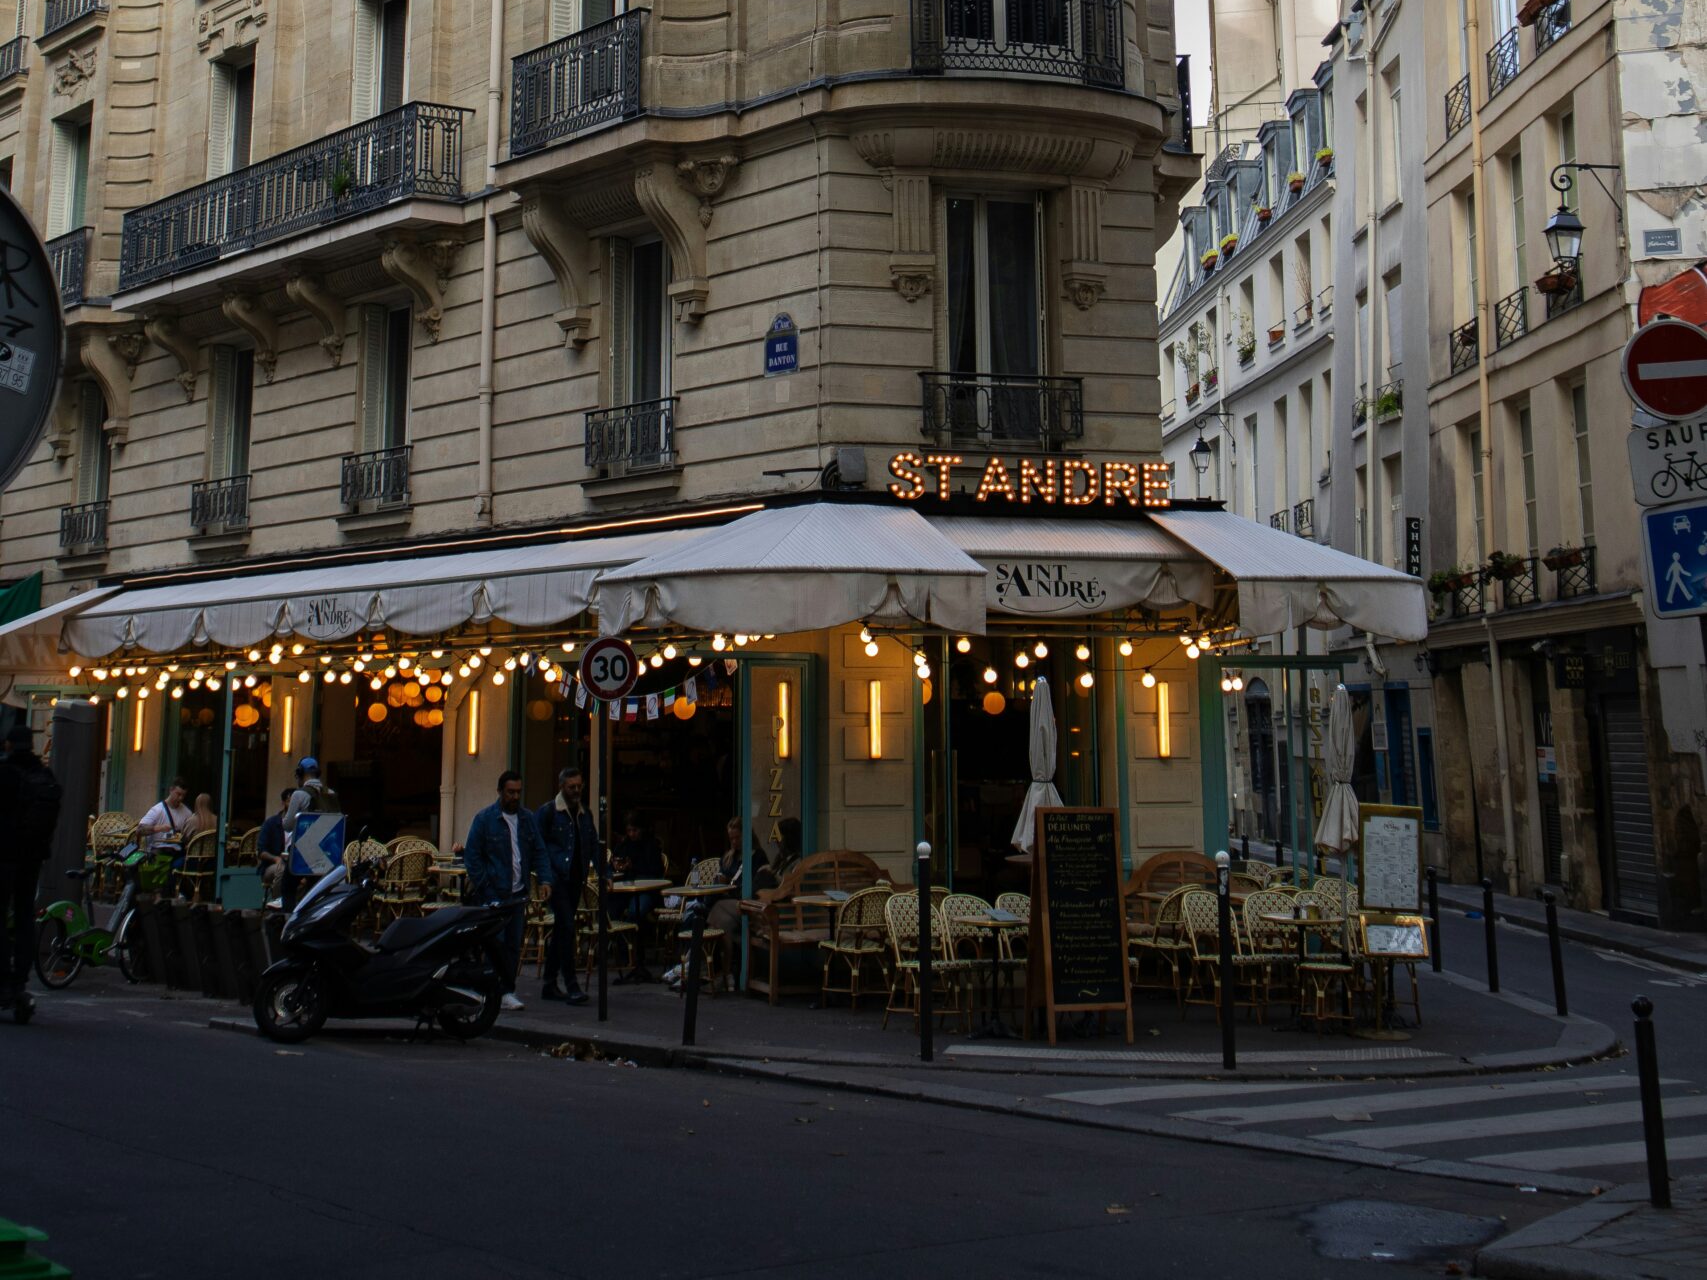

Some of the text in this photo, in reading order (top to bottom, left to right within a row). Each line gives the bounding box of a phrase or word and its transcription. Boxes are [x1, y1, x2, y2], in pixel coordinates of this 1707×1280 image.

[768, 354, 796, 367] DANTON
[775, 342, 788, 352] RUE
[886, 451, 1170, 508] ST ANDRE
[996, 569, 1102, 603] ANDRÉ
[593, 655, 628, 682] 30
[768, 715, 785, 843] PIZZA
